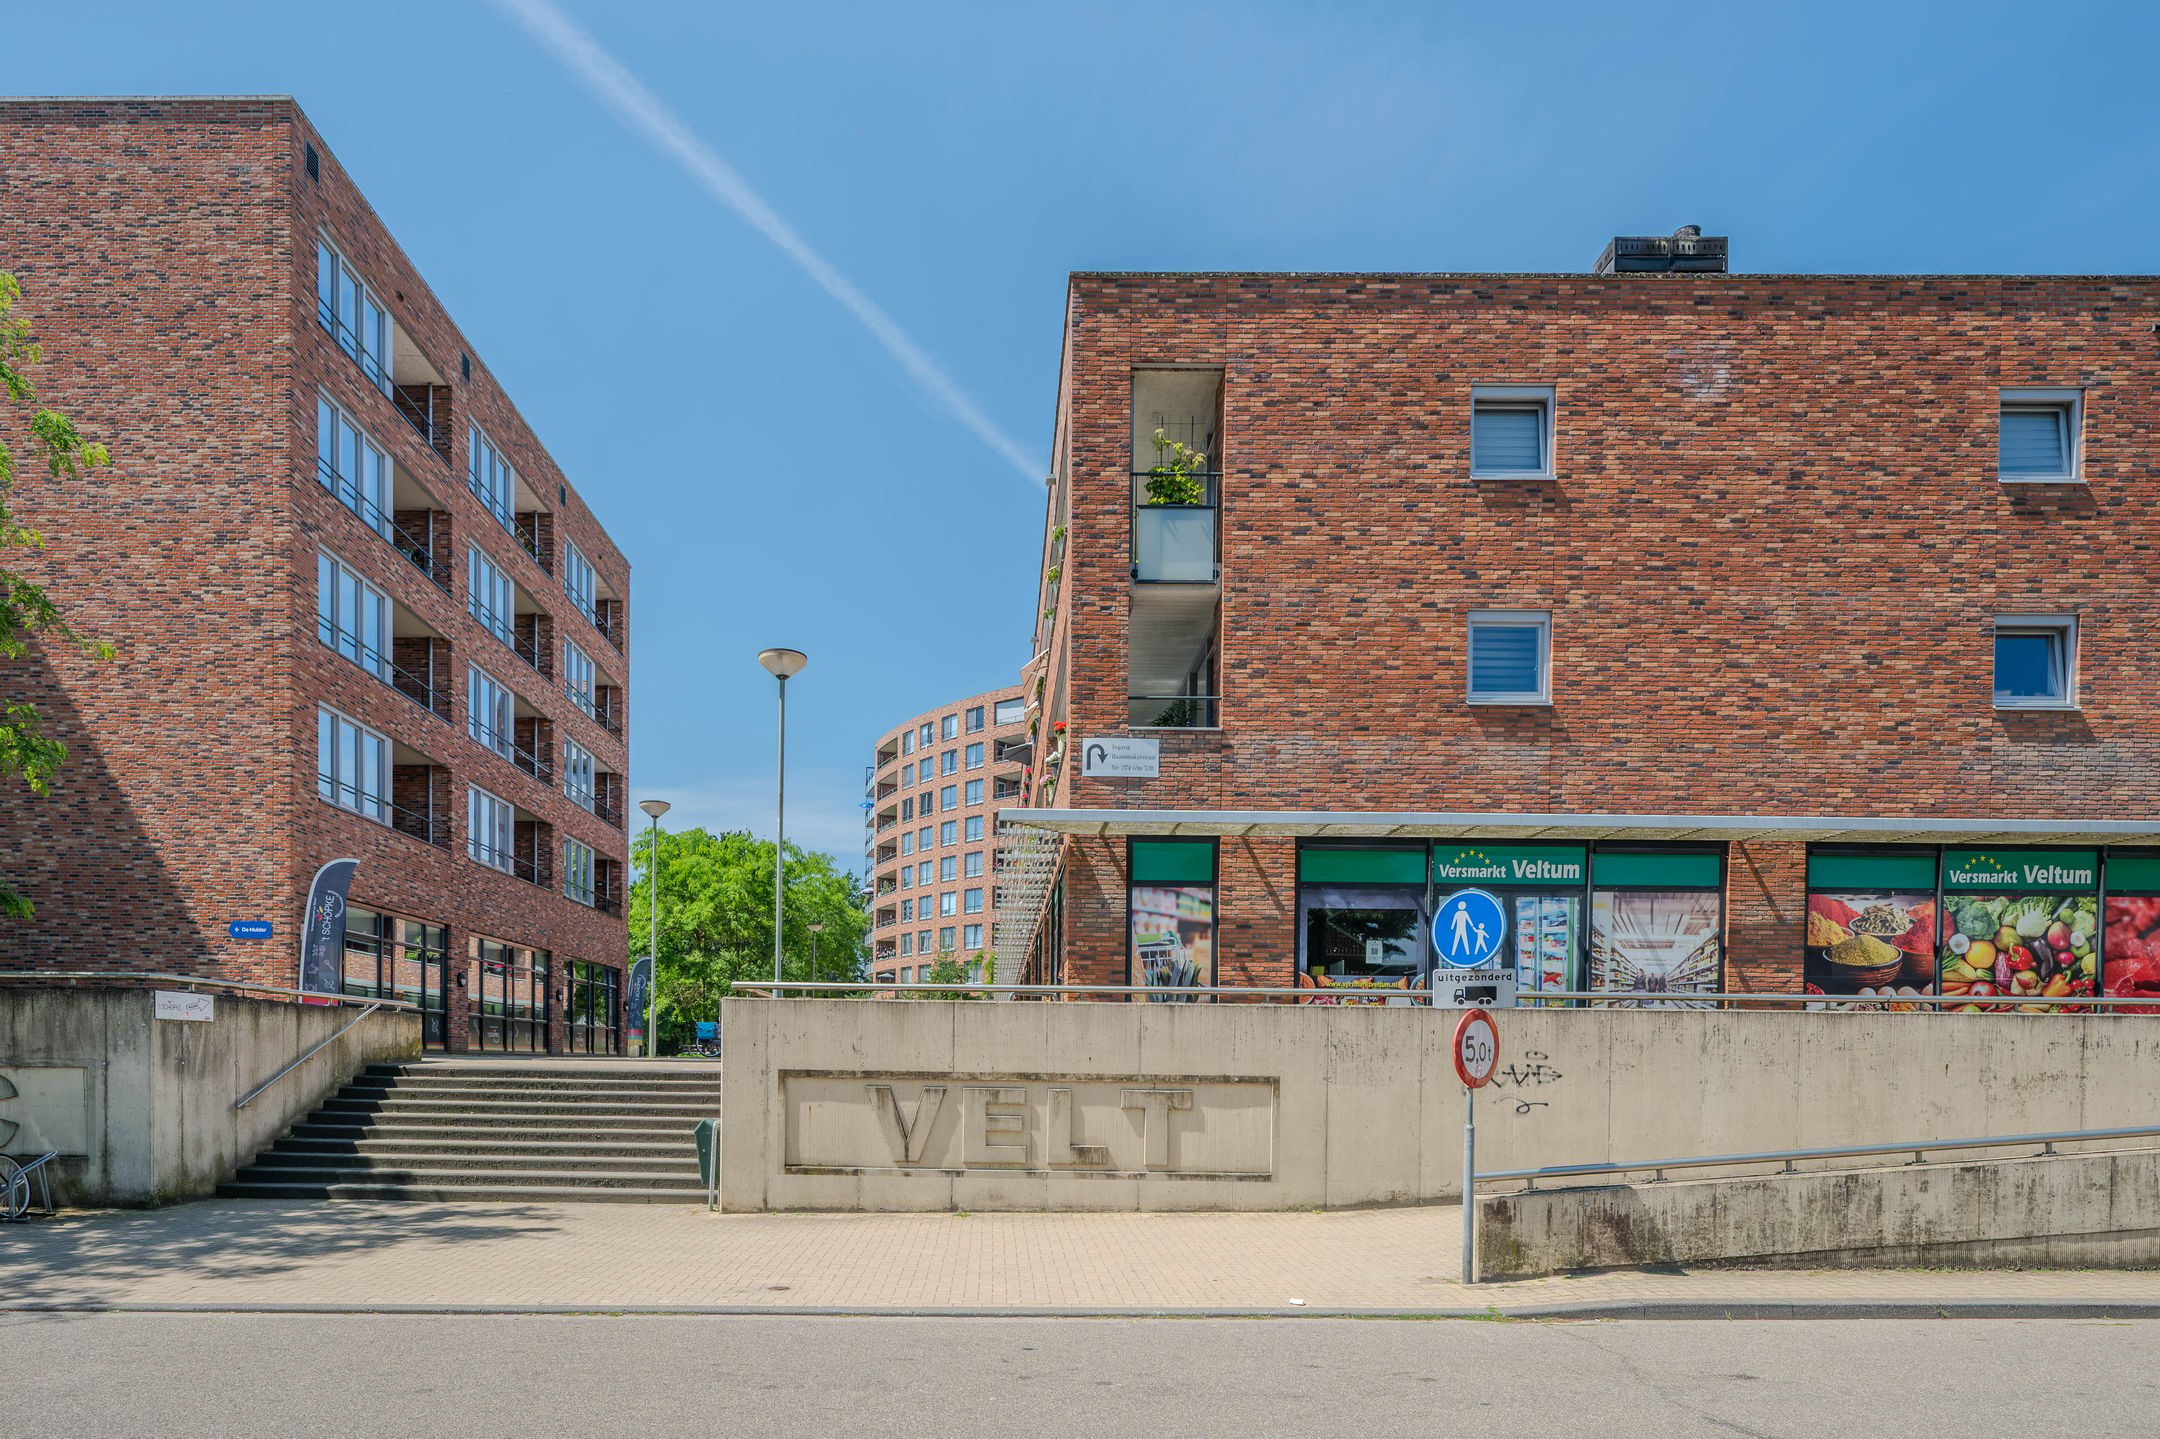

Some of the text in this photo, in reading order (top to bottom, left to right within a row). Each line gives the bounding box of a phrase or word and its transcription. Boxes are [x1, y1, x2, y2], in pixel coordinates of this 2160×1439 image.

[1439, 860, 1580, 879] Versmarkt Veltum
[1950, 865, 2092, 884] Versmarkt Veltum
[1438, 973, 1512, 984] uitgezonderd
[866, 1086, 1193, 1166] VELT
